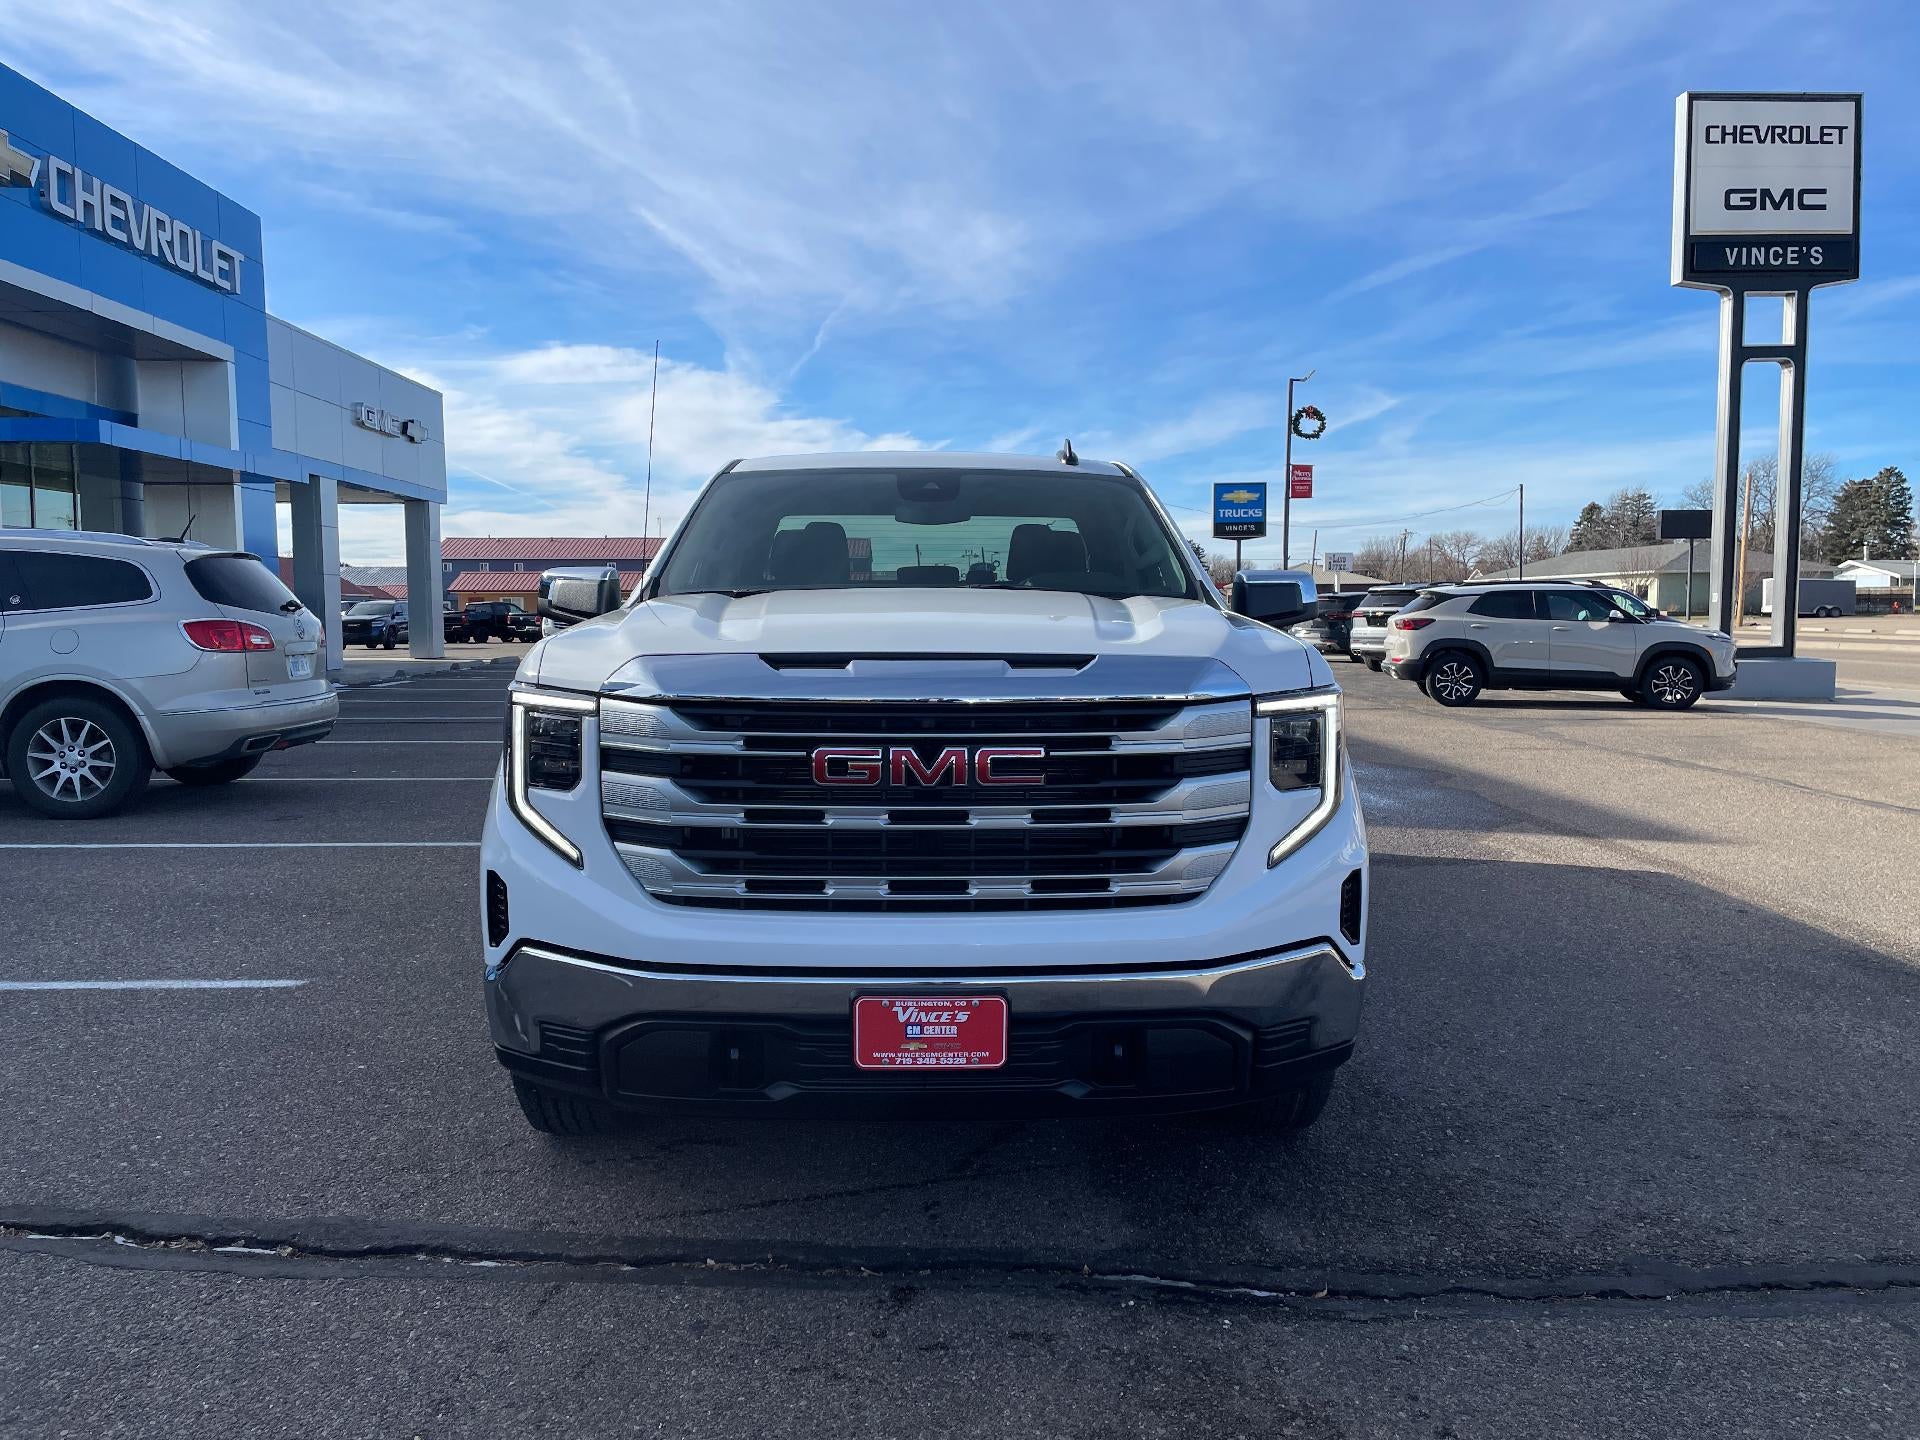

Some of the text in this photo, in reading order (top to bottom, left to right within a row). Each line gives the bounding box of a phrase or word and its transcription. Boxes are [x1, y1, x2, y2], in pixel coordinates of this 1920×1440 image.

[1705, 125, 1848, 144] CHEVROLET
[1724, 188, 1827, 210] GMC
[43, 154, 245, 296] CHEVROLET
[1725, 246, 1823, 265] VINCE'S
[355, 402, 401, 437] GMC
[1218, 508, 1263, 518] TRUCKS
[1225, 524, 1256, 532] VINCE'S
[811, 746, 1046, 786] GMC
[907, 1025, 958, 1035] GM CENTER
